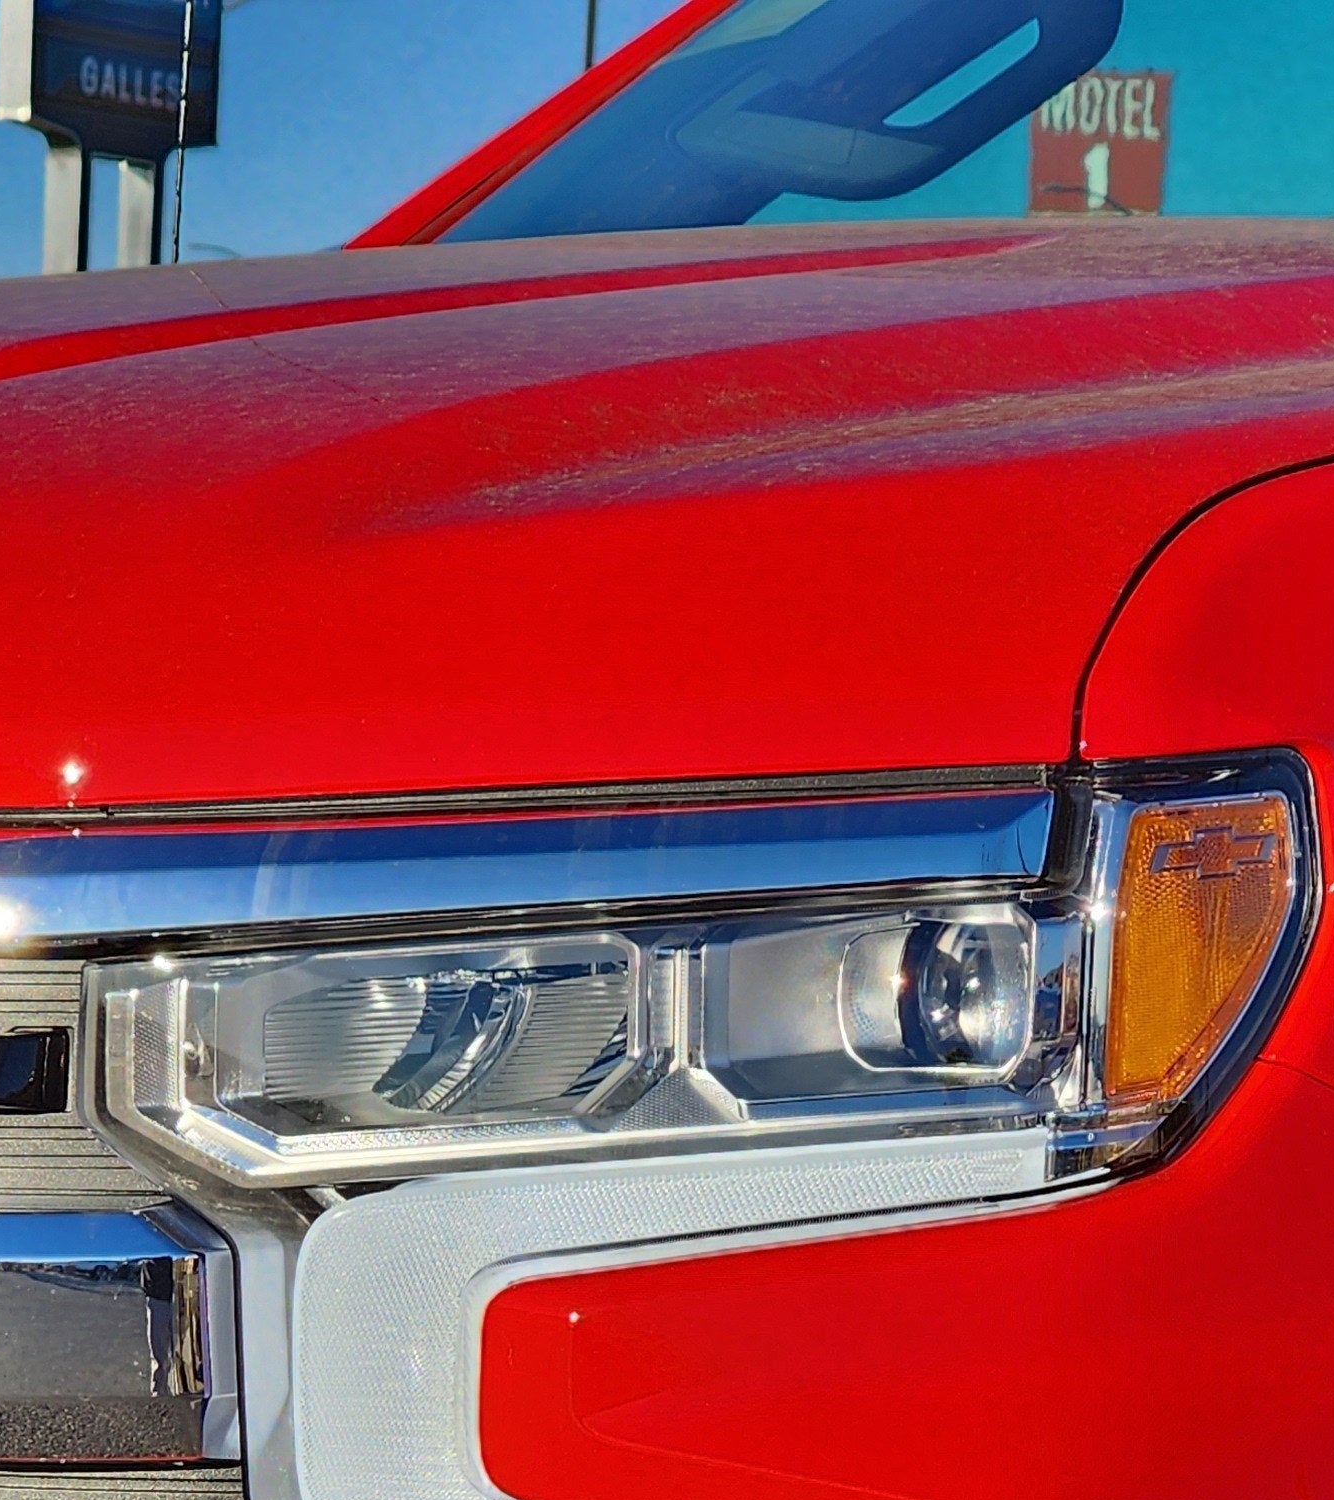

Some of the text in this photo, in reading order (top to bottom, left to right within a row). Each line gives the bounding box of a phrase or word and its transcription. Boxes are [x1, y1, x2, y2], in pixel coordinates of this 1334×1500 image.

[81, 55, 180, 111] GALLES
[1040, 77, 1162, 142] MOTEL
[1083, 141, 1110, 209] 1
